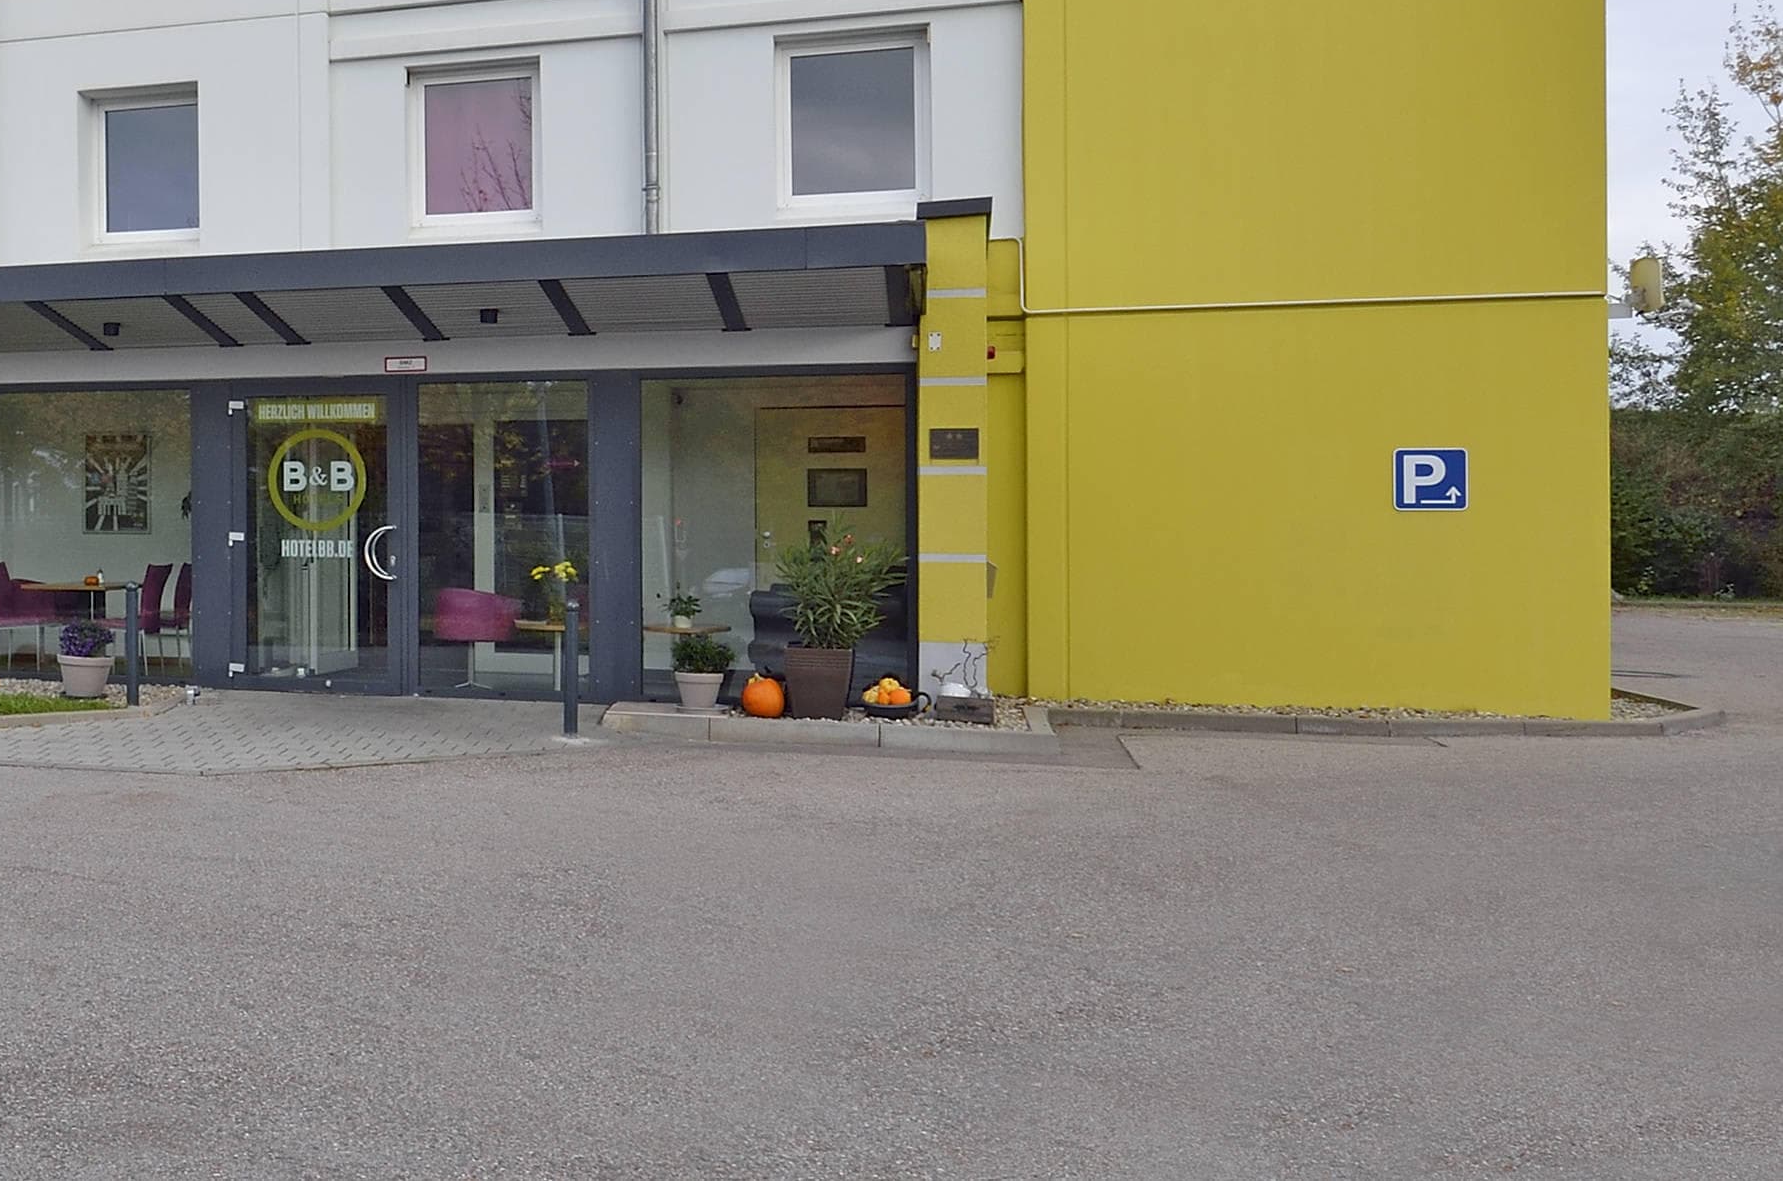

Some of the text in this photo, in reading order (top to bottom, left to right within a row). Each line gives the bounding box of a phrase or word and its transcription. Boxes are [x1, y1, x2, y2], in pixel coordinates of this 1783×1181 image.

[258, 403, 376, 420] HERZLICH WILLKOMMEN
[283, 461, 355, 491] B&B
[1403, 454, 1446, 504] P
[281, 539, 354, 558] HOTELBB.DE
